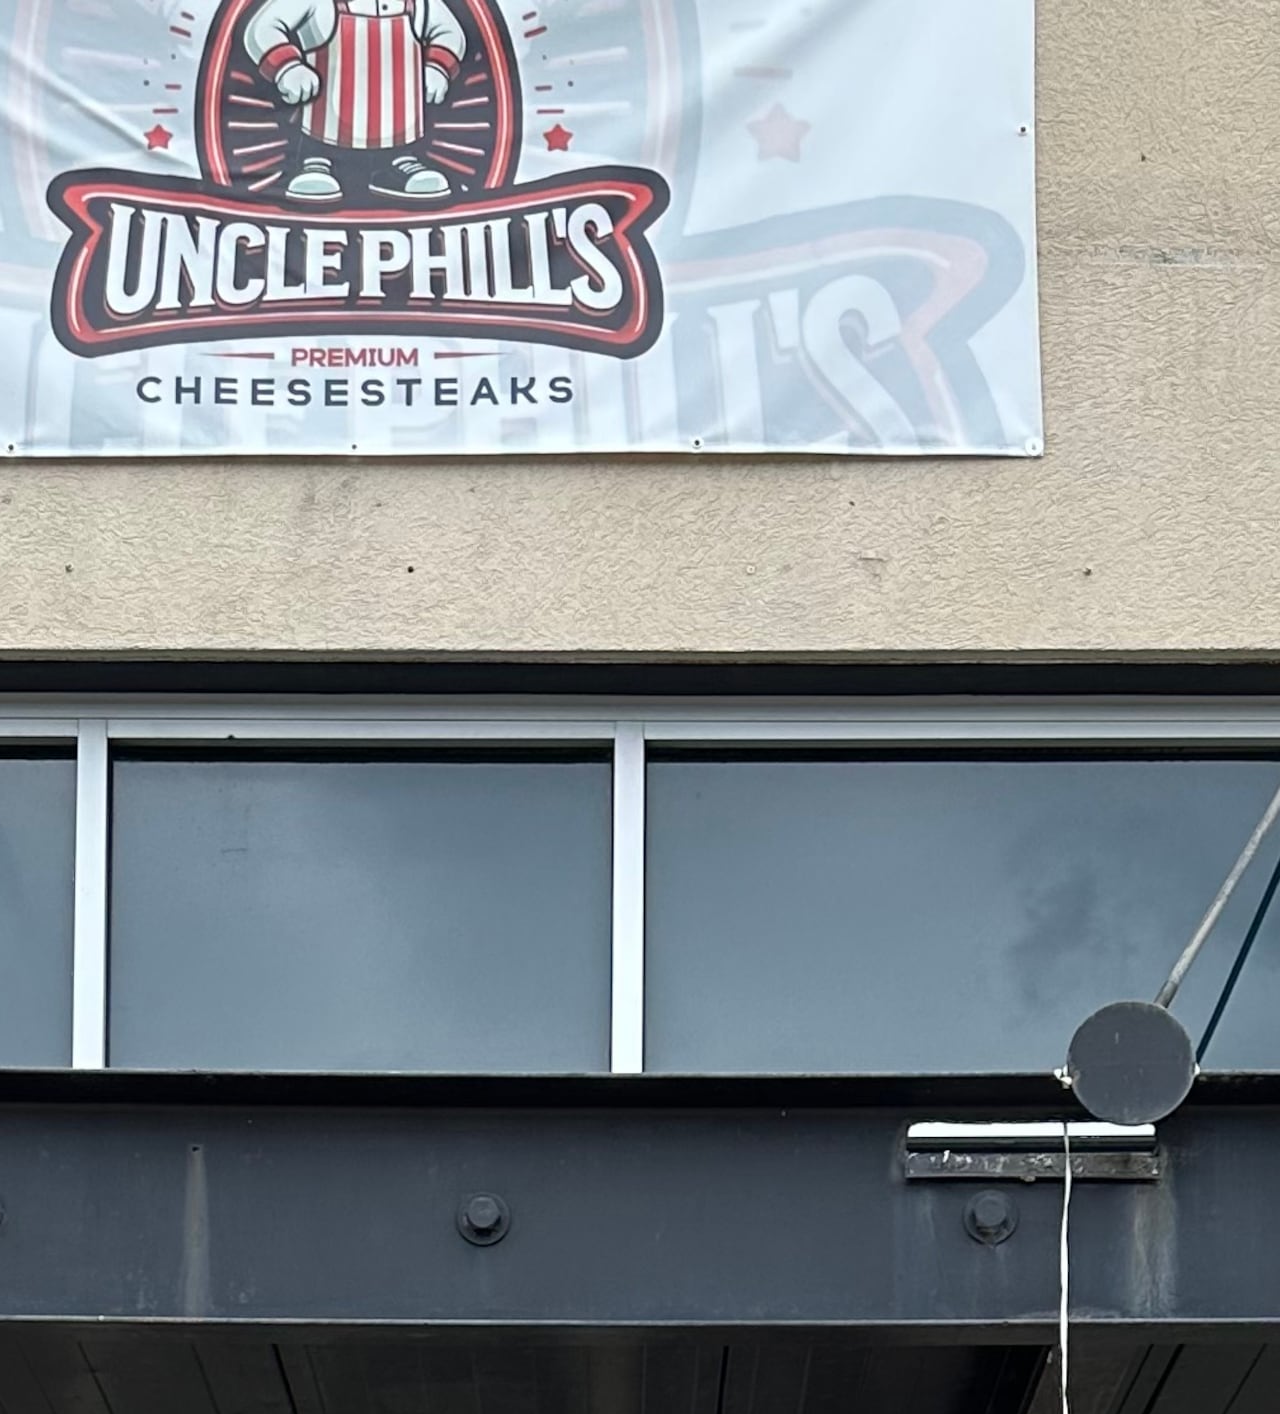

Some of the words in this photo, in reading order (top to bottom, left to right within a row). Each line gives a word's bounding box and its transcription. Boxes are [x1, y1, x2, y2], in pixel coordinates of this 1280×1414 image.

[105, 203, 350, 316] UNCLE
[358, 203, 624, 312] PHILL'S
[290, 347, 419, 368] PREMIUM
[136, 375, 575, 407] CHEESESTEAKS
